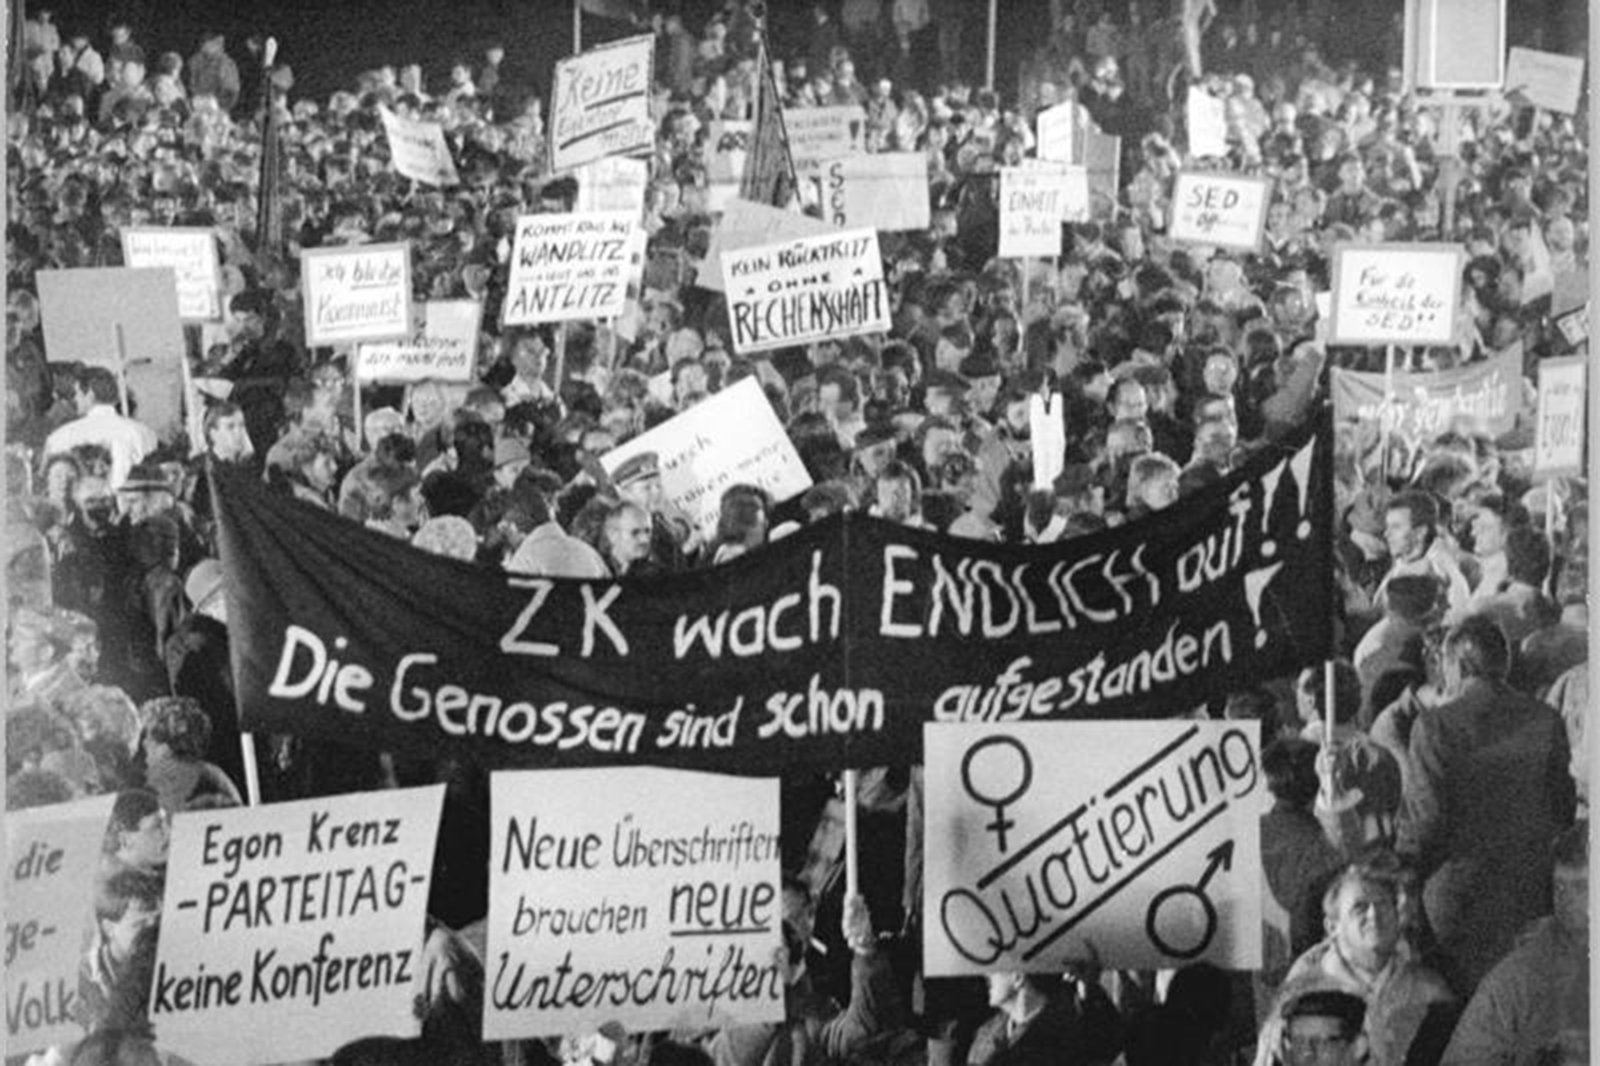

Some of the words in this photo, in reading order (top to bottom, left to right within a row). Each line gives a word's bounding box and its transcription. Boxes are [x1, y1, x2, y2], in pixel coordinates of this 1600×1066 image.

[1186, 184, 1239, 209] SED
[519, 239, 624, 268] WANDLITZ
[732, 256, 770, 276] KEIN
[766, 272, 832, 294] OHNE
[510, 281, 617, 317] ANTLITZ
[731, 279, 887, 344] RECHENSCHAFT
[499, 577, 630, 657] ZK
[673, 549, 842, 659] wach
[879, 543, 1160, 638] ENDLICH
[269, 625, 374, 713] Die
[391, 653, 646, 753] Genossen
[656, 695, 744, 748] sind
[758, 672, 884, 739] schon
[14, 841, 64, 881] die
[202, 823, 283, 879] Egon
[306, 811, 402, 854] Krenz
[503, 815, 602, 874] Neue
[612, 813, 781, 870] Überschriften
[941, 728, 1257, 966] Quotierung
[511, 896, 648, 937] brauchen
[669, 881, 776, 929] neue
[153, 961, 243, 1014] keine
[250, 931, 413, 1007] Konferenz
[492, 944, 781, 1020] Unterschriften
